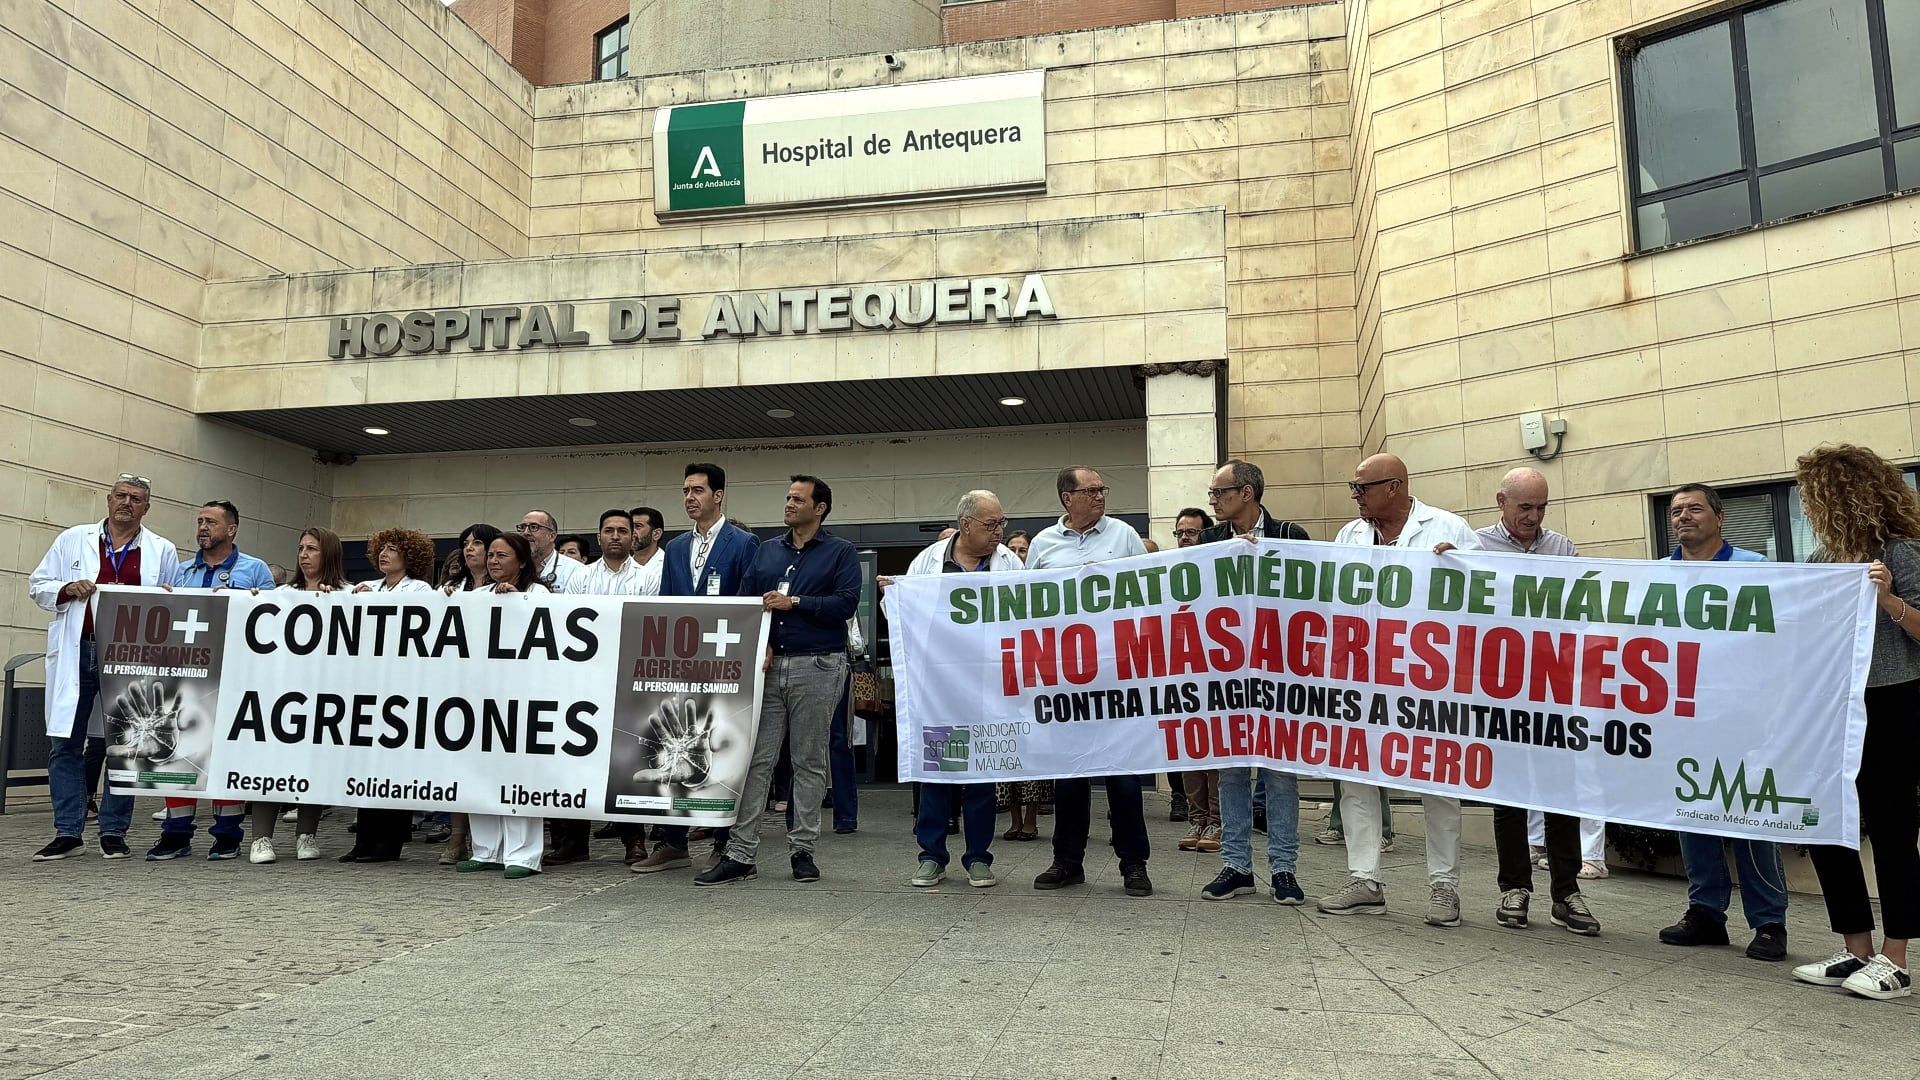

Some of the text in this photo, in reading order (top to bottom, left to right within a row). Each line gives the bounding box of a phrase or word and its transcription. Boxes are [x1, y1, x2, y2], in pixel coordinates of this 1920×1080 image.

[762, 125, 1021, 166] Hospital de Antequera
[672, 177, 741, 191] Junta de Andalucía
[329, 274, 1057, 358] HOSPITAL DE ANTEQUERA
[949, 550, 1776, 634] SINDICATO MÉDICO DE MÁLAGA
[244, 603, 600, 662] CONTRA LAS
[103, 664, 209, 678] AL PERSONAL DE SANIDAD
[104, 643, 211, 666] AGRESIONES
[633, 658, 743, 681] AGRESIONES
[1000, 623, 1098, 697] ¡NO
[632, 681, 740, 694] AL PERSONAL DE SANIDAD
[227, 690, 600, 757] AGRESIONES
[971, 721, 1031, 739] SINDICATO
[1034, 687, 1145, 725] CONTRA
[1150, 681, 1201, 715] LAS
[1368, 692, 1390, 726] A
[1396, 695, 1653, 759] SANITARIAS-OS
[974, 738, 1017, 754] MÉDICO
[975, 755, 1023, 772] MÁLAGA
[1380, 731, 1494, 790] CERO
[226, 771, 587, 809] Respeto Solidaridad Libertad
[1675, 756, 1779, 815] SMA
[1675, 808, 1806, 831] Sindicato Médico Andaluz
